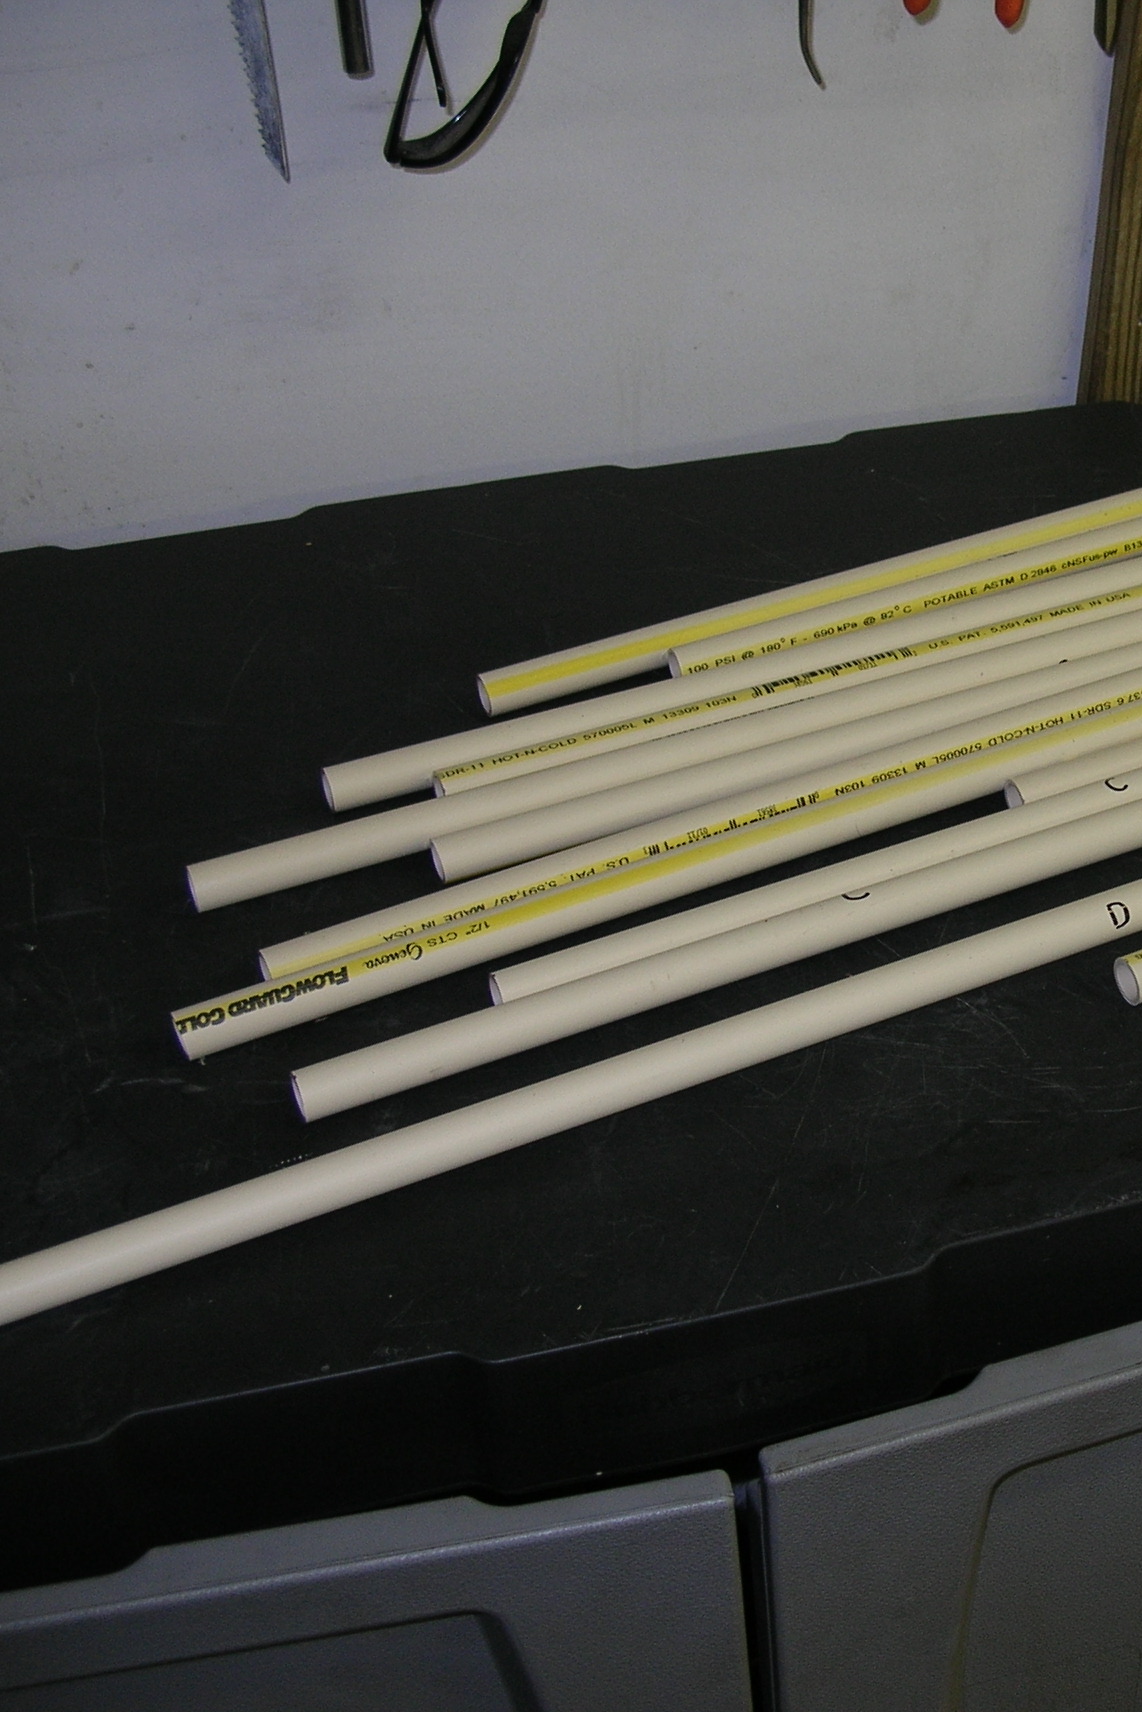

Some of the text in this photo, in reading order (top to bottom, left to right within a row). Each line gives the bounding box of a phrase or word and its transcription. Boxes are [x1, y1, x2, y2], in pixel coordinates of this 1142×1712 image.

[1049, 604, 1084, 618] MADE
[1105, 592, 1131, 604] USA
[688, 662, 709, 675] 100
[715, 655, 736, 666] PSI
[813, 627, 835, 640] 690
[836, 620, 858, 634] kPa
[924, 586, 978, 609] POTABLE
[982, 576, 1016, 593] ASTM
[1020, 571, 1029, 582] D
[1030, 564, 1057, 579] 2846
[643, 717, 655, 725] M
[662, 705, 700, 720] 13309
[705, 695, 737, 709] 103N
[1070, 700, 1112, 722] SDR-11
[871, 766, 908, 783] 13309
[915, 761, 926, 770] M
[834, 781, 866, 796] 103N
[443, 903, 486, 922] MADE
[1106, 901, 1131, 930] D
[382, 927, 414, 942] USA
[421, 920, 436, 931] IN
[426, 931, 458, 948] CTS
[364, 942, 423, 969] Genova
